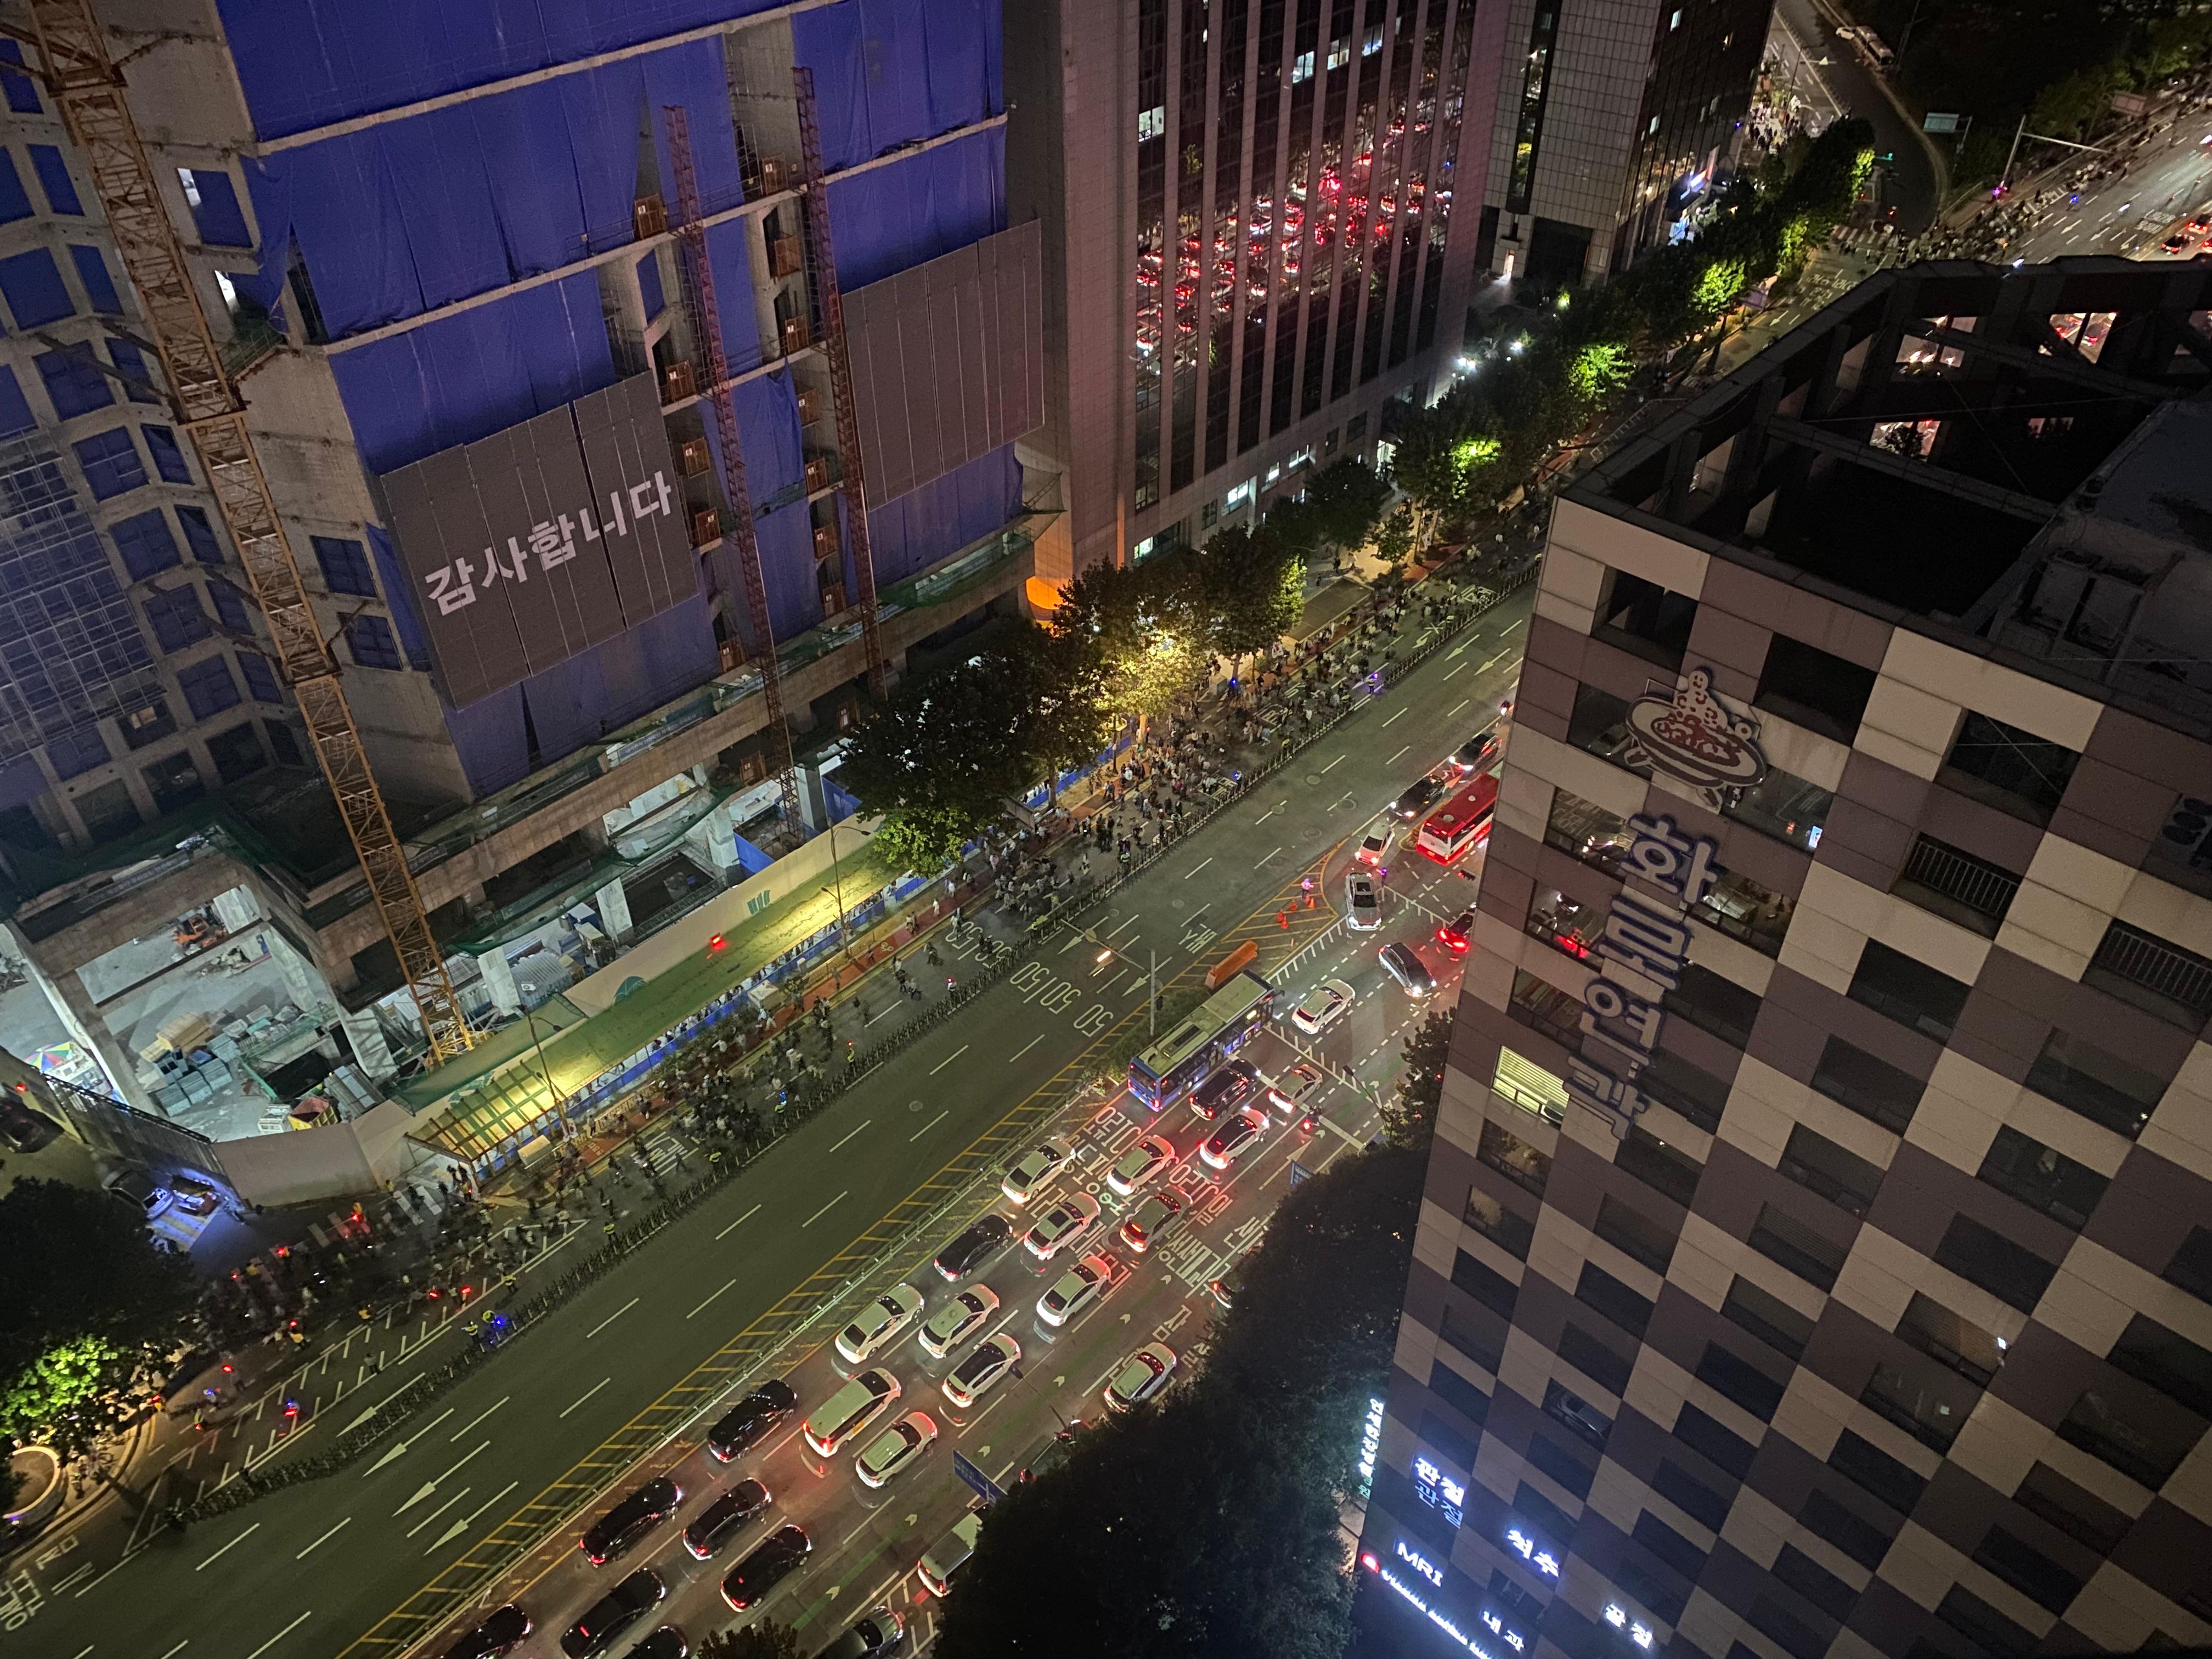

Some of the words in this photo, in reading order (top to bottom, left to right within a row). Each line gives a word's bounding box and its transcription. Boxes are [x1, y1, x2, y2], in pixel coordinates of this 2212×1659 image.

[425, 470, 672, 616] 감사합니다
[1009, 961, 1050, 994] 50
[1040, 981, 1081, 1015] 50
[1073, 1004, 1114, 1037] 50
[1415, 1457, 1464, 1507] 관절
[1398, 1542, 1443, 1587] MRI
[1508, 1530, 1559, 1577] 척추
[1483, 1610, 1524, 1651] 내과
